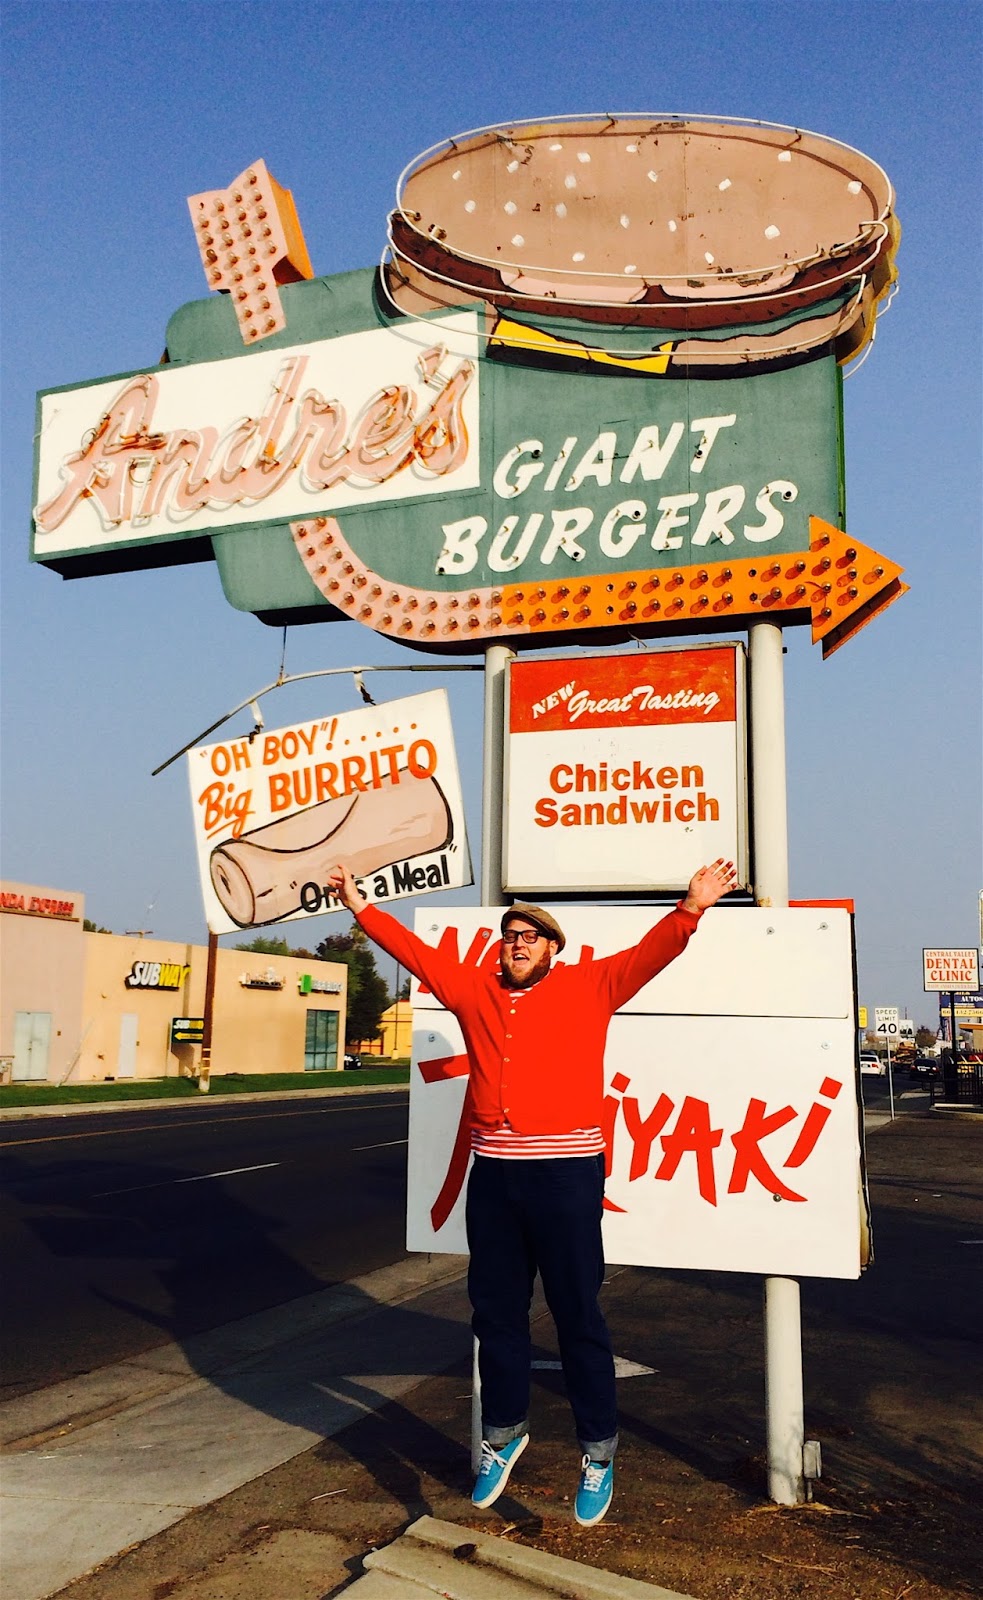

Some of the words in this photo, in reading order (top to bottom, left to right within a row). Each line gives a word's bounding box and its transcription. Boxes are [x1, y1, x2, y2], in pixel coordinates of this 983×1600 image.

[33, 342, 476, 534] Andre's
[493, 413, 737, 499] GIANT
[435, 480, 798, 576] BURGERS
[531, 681, 576, 719] NEW
[567, 690, 634, 722] Great
[631, 685, 720, 714] Tasting
[198, 781, 255, 839] Big
[268, 739, 438, 814] BURRITO
[550, 761, 704, 794] Chicken
[534, 792, 720, 828] Sandwich
[374, 875, 390, 898] a
[128, 961, 192, 988] SUBWAY
[926, 958, 976, 969] DENTAL
[930, 970, 972, 982] CLINIC
[877, 1023, 898, 1034] 40
